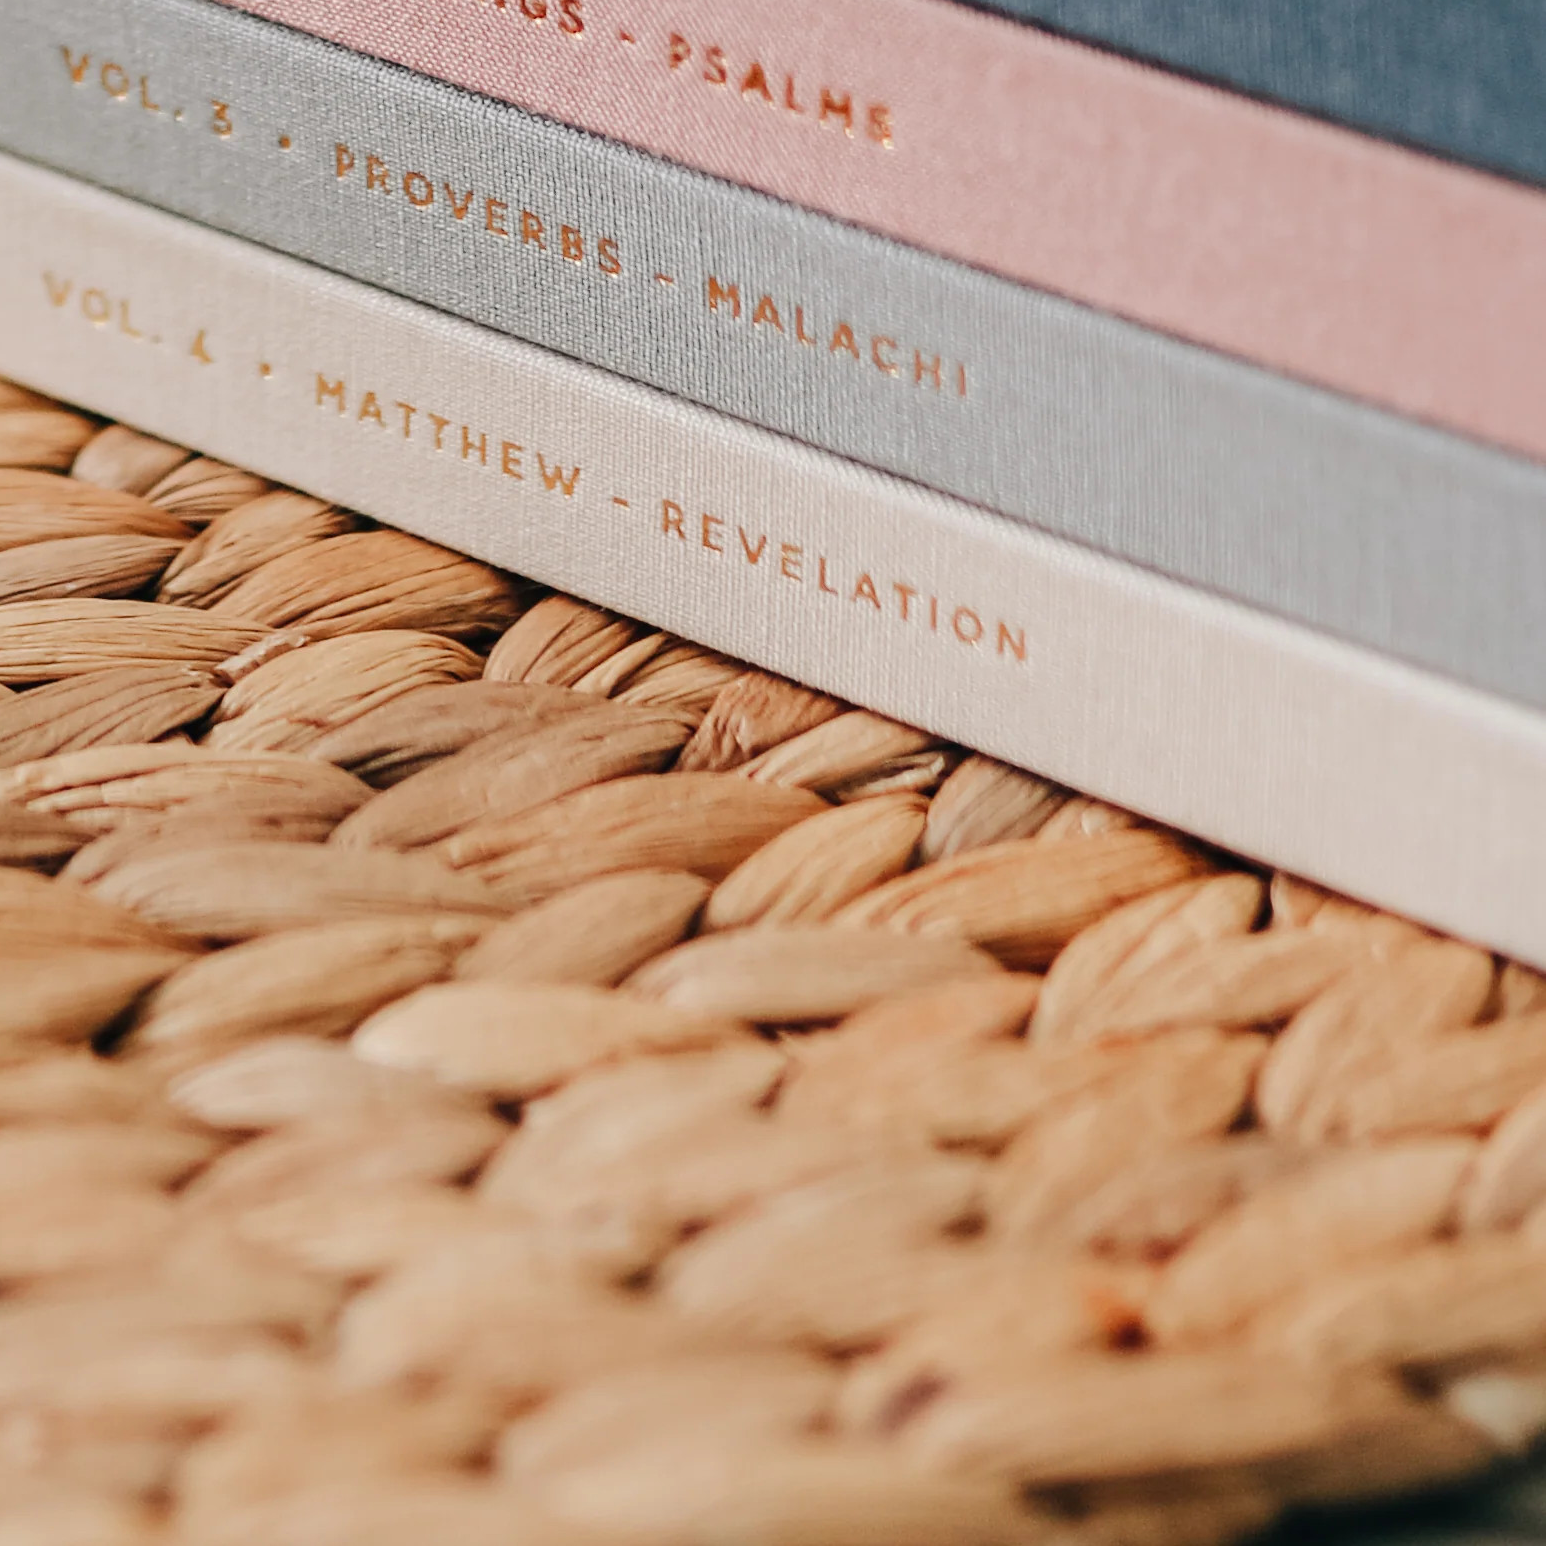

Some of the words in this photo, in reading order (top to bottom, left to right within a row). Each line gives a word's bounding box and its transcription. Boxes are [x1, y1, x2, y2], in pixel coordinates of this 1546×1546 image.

[58, 44, 185, 122] VOL.
[210, 98, 235, 140] 3
[334, 140, 622, 278] PROVERBS
[707, 274, 970, 398] MALACHI
[668, 30, 896, 151] PSALMS
[41, 269, 163, 346] VOL.
[315, 371, 581, 499] MATTHEW
[661, 497, 1029, 663] REVELATION
